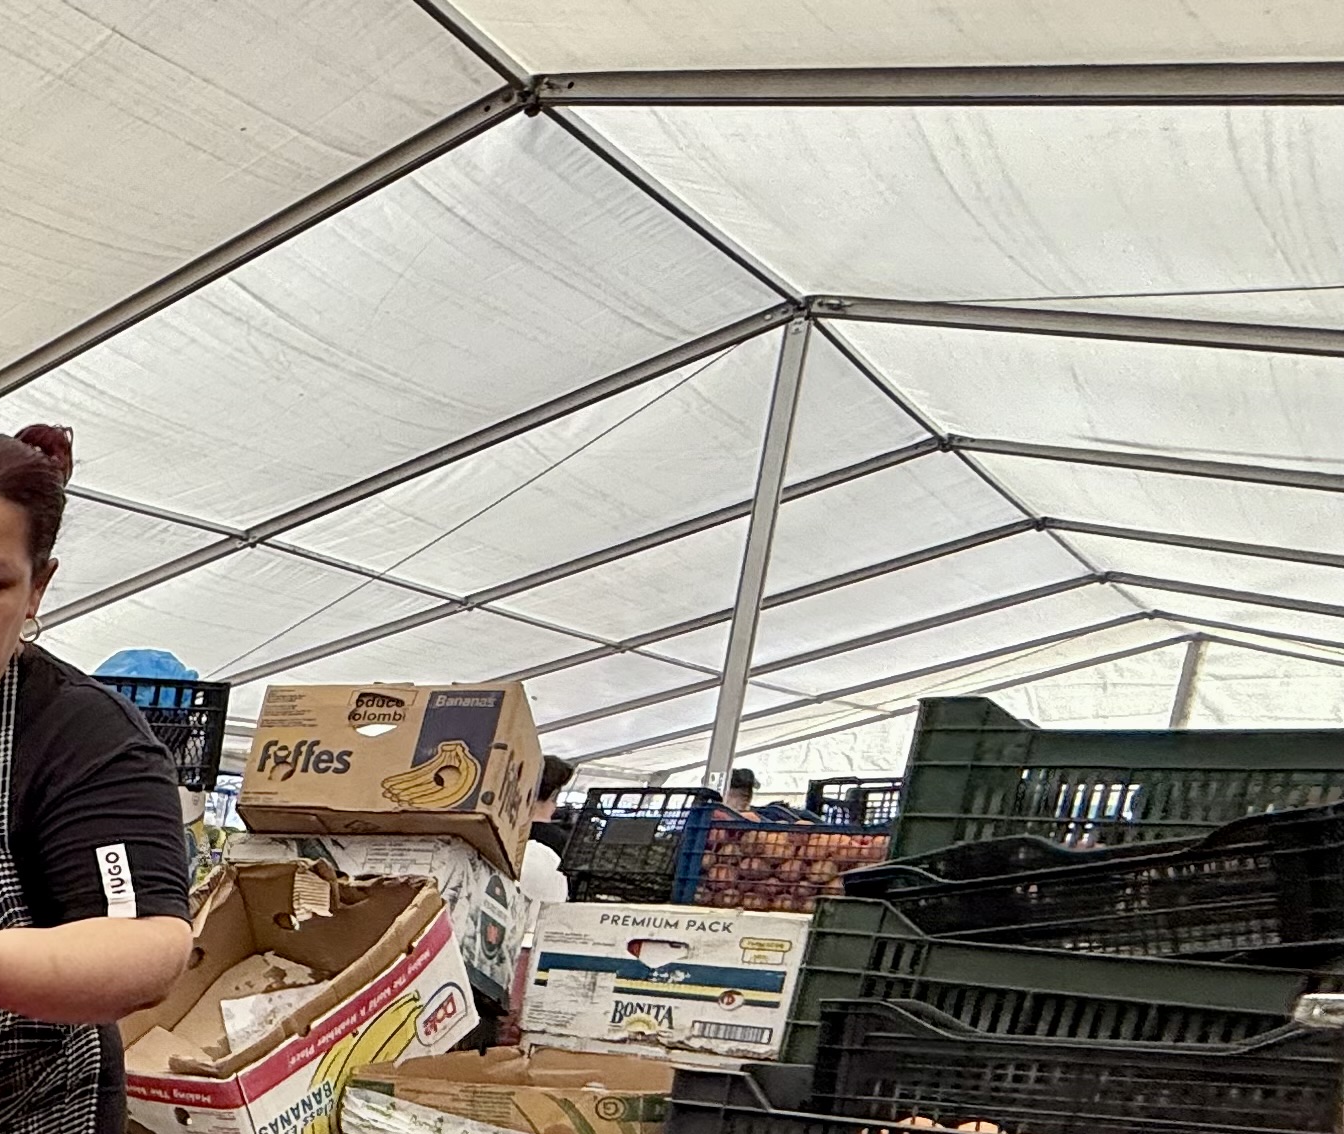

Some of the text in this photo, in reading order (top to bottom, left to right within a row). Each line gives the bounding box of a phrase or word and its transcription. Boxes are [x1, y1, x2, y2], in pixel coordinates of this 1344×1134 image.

[435, 694, 497, 709] Bananas
[599, 913, 734, 934] PREMIUM PACK
[423, 991, 458, 1037] Dole
[610, 1000, 675, 1030] BONITA
[301, 1098, 334, 1127] Class
